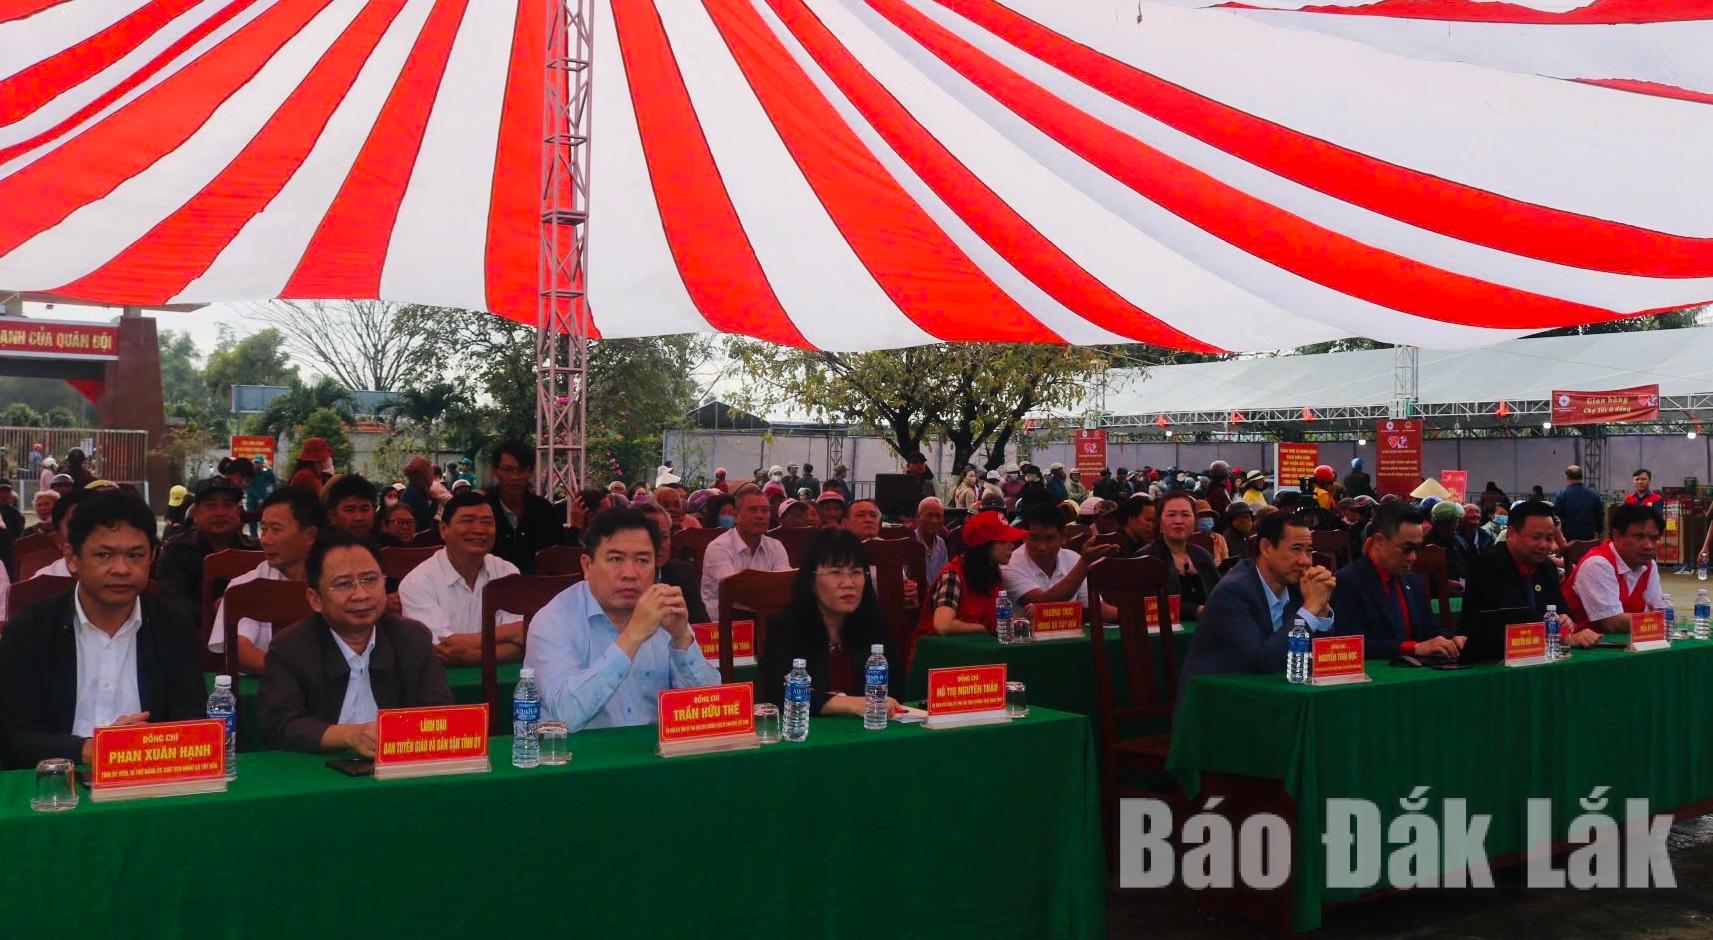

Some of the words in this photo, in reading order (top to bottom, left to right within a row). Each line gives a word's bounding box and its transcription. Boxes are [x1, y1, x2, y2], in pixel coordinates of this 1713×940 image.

[28, 326, 53, 346] CỦA
[56, 331, 89, 348] QUÂN
[92, 332, 112, 352] ĐỘI
[694, 694, 710, 704] ĐỒNG
[710, 694, 720, 702] CHÍ
[673, 704, 698, 721] TRẦN
[702, 704, 720, 718] HỮU
[722, 701, 740, 715] THẾ
[420, 718, 434, 732] LÃNH
[436, 718, 447, 734] ĐẠO
[142, 734, 164, 744] ĐỒNG
[165, 732, 179, 742] CHÍ
[384, 742, 396, 754] BAN
[396, 739, 414, 754] TUYÊN
[414, 738, 428, 752] GIÁO
[428, 738, 436, 752] VÀ
[436, 736, 448, 750] DÂN
[450, 736, 460, 752] VẬN
[461, 734, 474, 750] TỈNH
[474, 733, 482, 748] ỦY
[109, 750, 142, 764] PHAN
[145, 745, 177, 761] XUÂN
[180, 744, 211, 760] HẠNH
